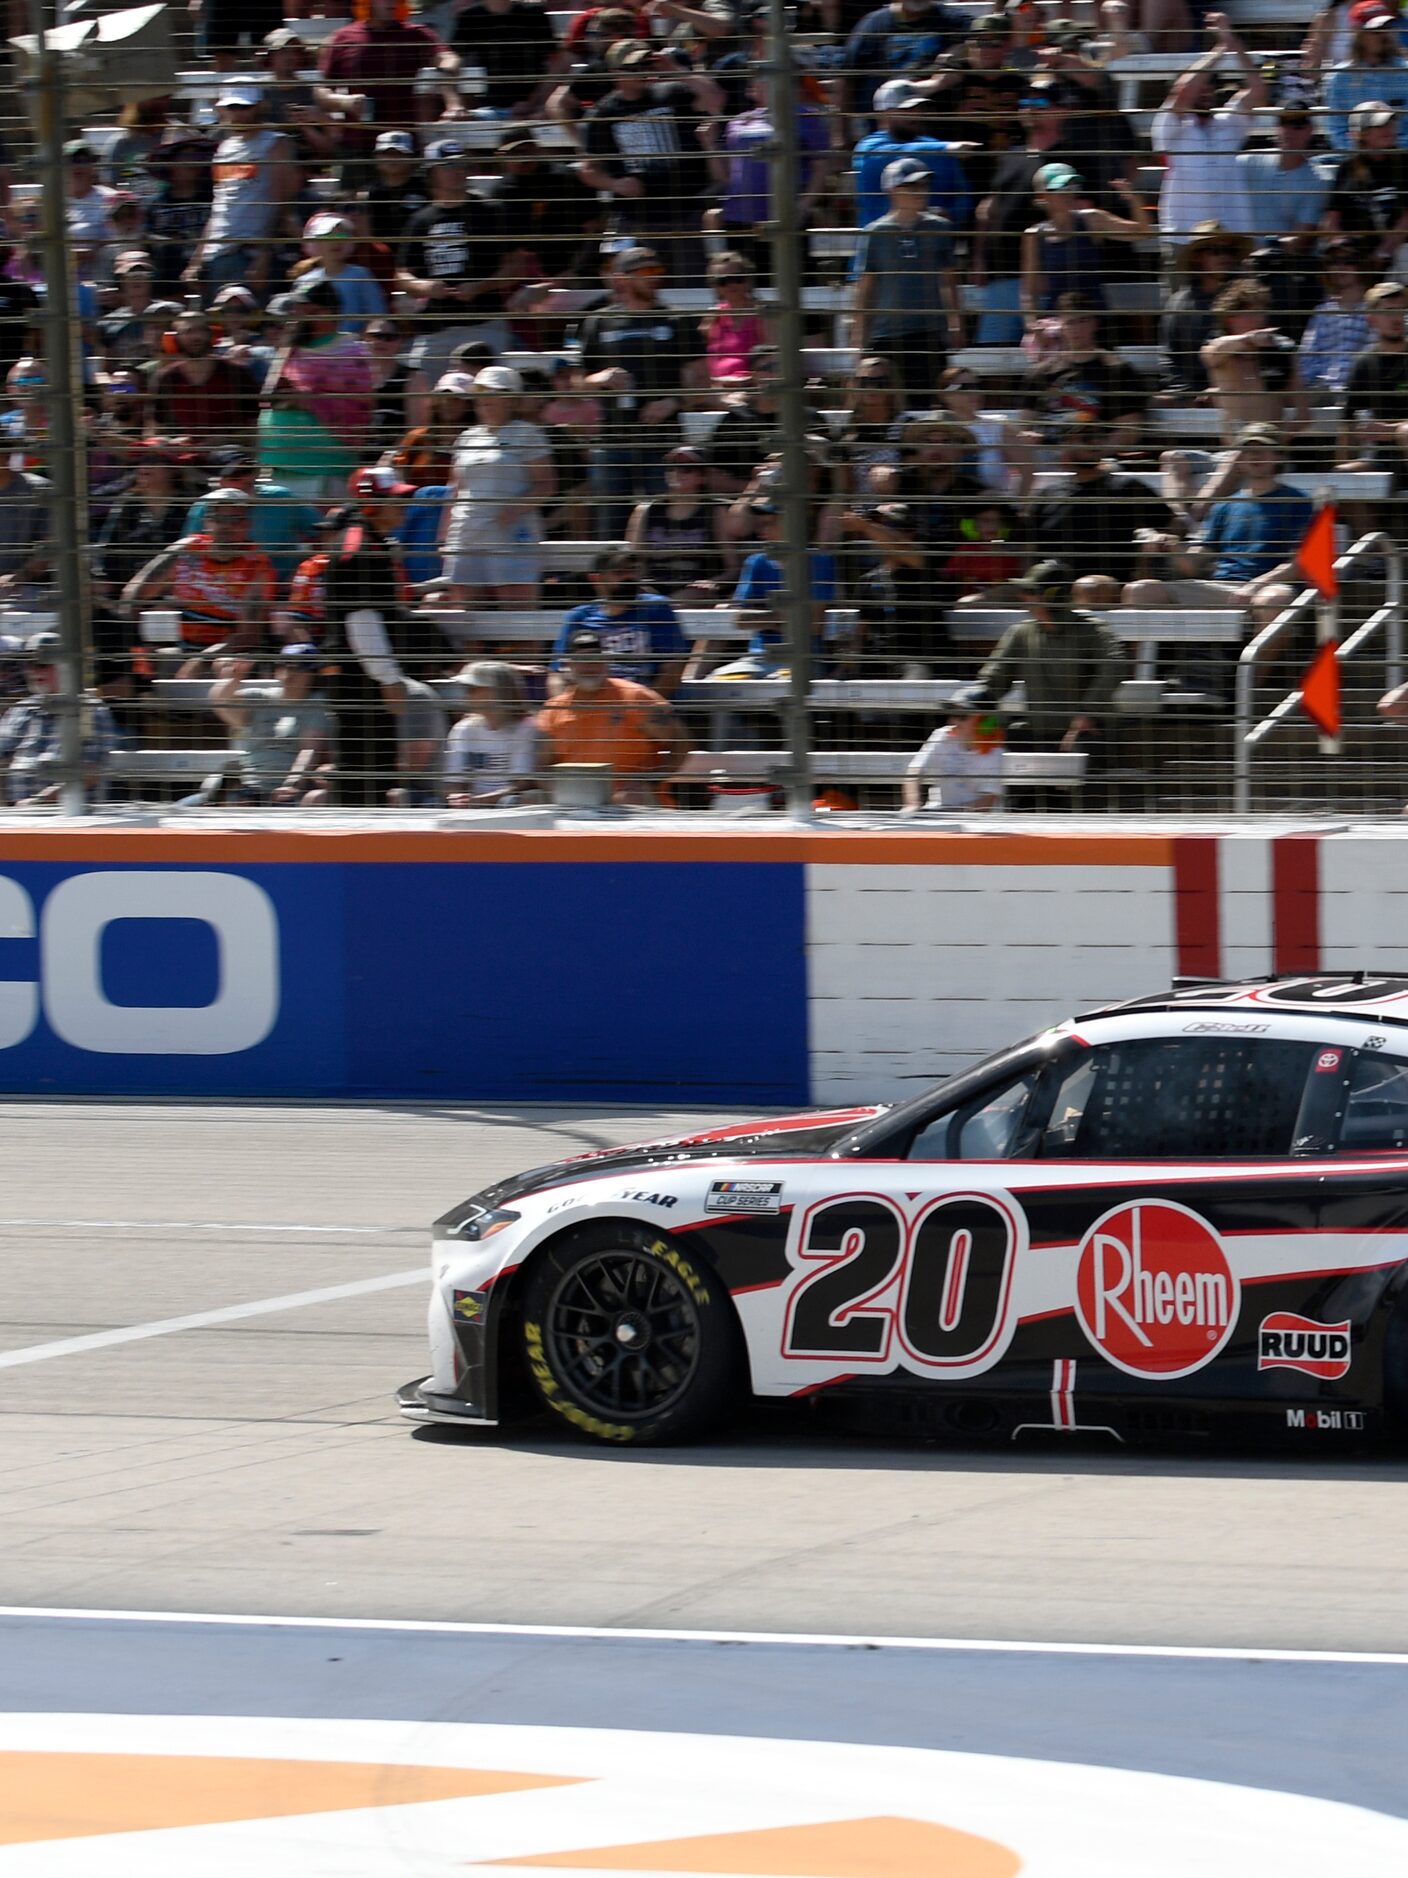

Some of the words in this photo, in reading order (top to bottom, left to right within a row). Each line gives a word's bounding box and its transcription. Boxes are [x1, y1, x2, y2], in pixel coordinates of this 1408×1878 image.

[716, 1195, 738, 1206] CUP
[738, 1196, 770, 1207] SERIES
[735, 1183, 774, 1193] NASCAR
[651, 1239, 710, 1305] EAGLE
[781, 1190, 1018, 1367] 20
[1093, 1207, 1228, 1347] Rheem
[1261, 1332, 1348, 1359] RUUD
[1286, 1408, 1341, 1429] Mobil
